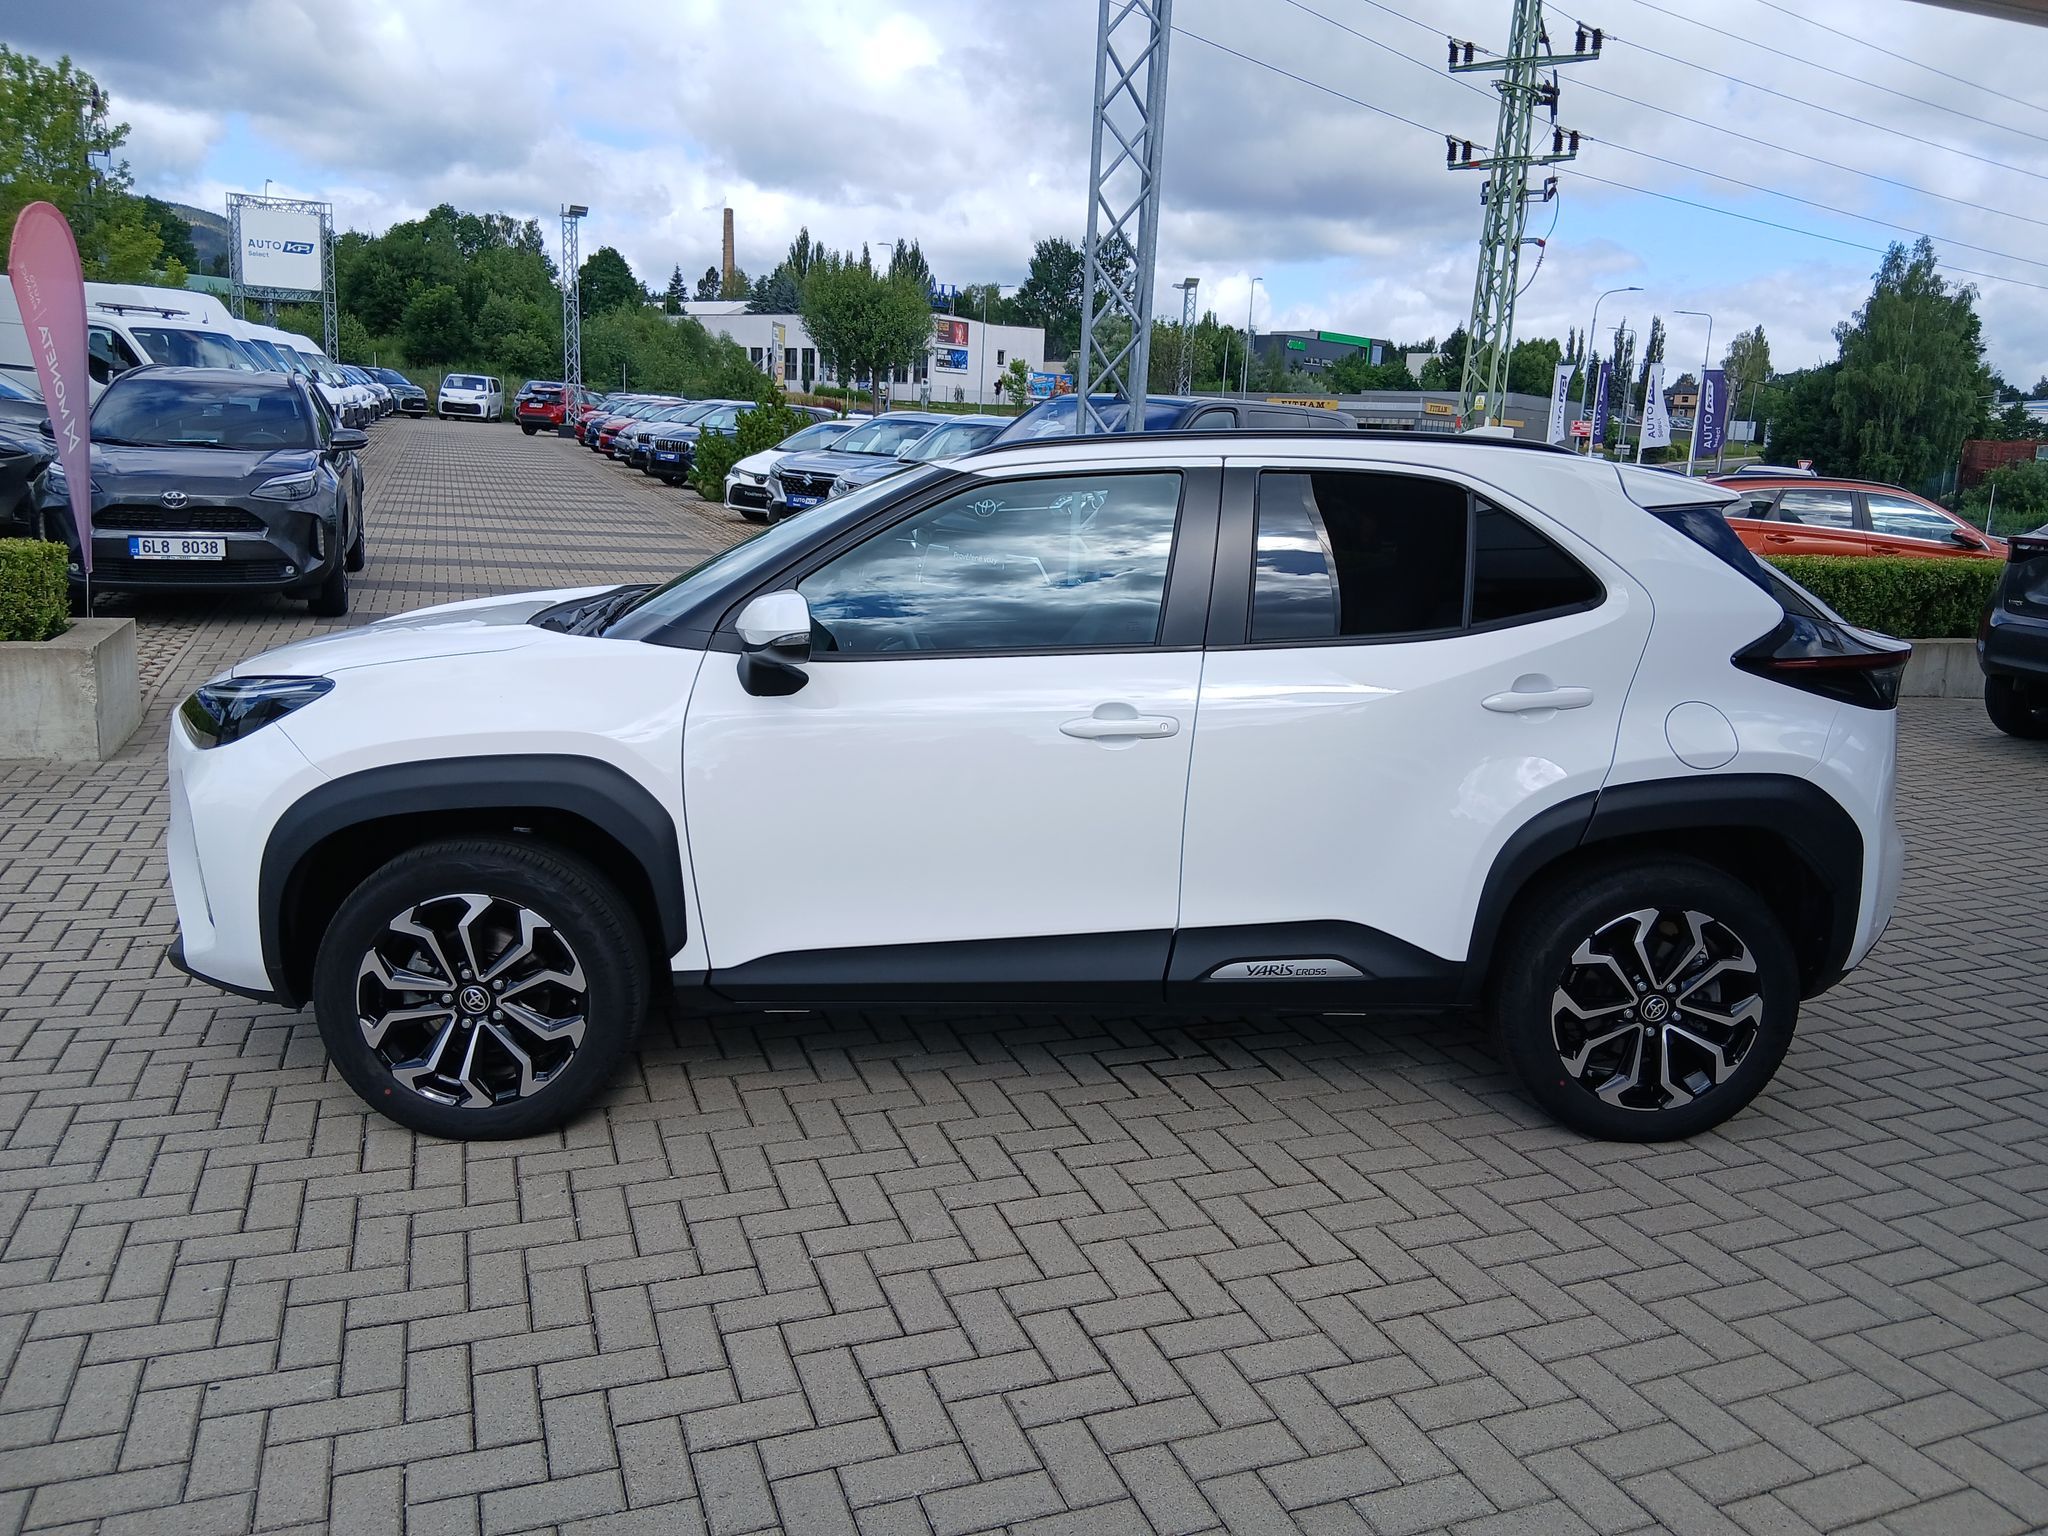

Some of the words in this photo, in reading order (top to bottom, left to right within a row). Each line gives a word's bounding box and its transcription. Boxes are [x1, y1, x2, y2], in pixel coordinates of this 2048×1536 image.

[248, 239, 281, 250] AUTO
[1646, 406, 1656, 439] AUTO
[1703, 414, 1713, 449] AUTO
[142, 540, 170, 554] 6L8
[181, 541, 218, 554] 8038
[1296, 968, 1327, 976] CROSS
